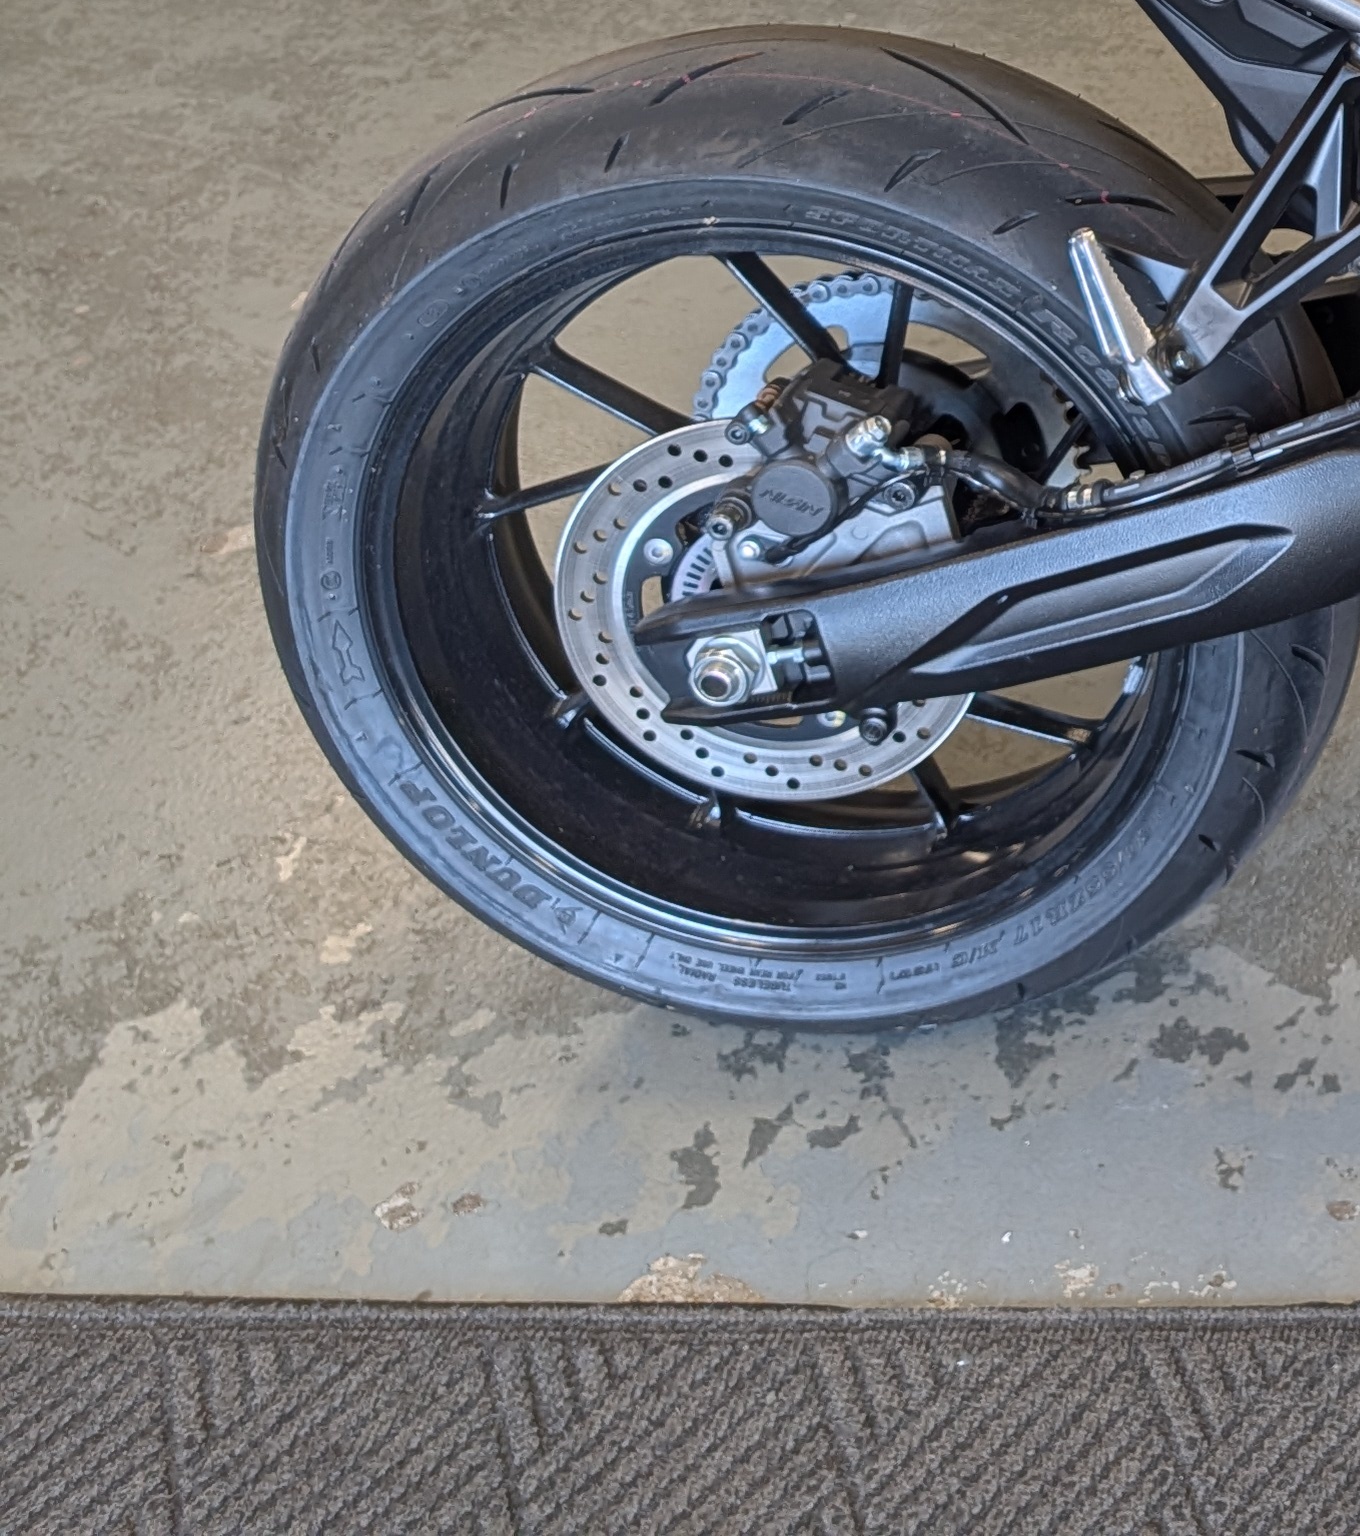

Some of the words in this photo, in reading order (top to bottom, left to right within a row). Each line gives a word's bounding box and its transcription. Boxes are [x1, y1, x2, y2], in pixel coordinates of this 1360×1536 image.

[397, 775, 556, 912] DUNLOP
[678, 964, 716, 983] RADIAL
[732, 976, 791, 993] TUBELESS
